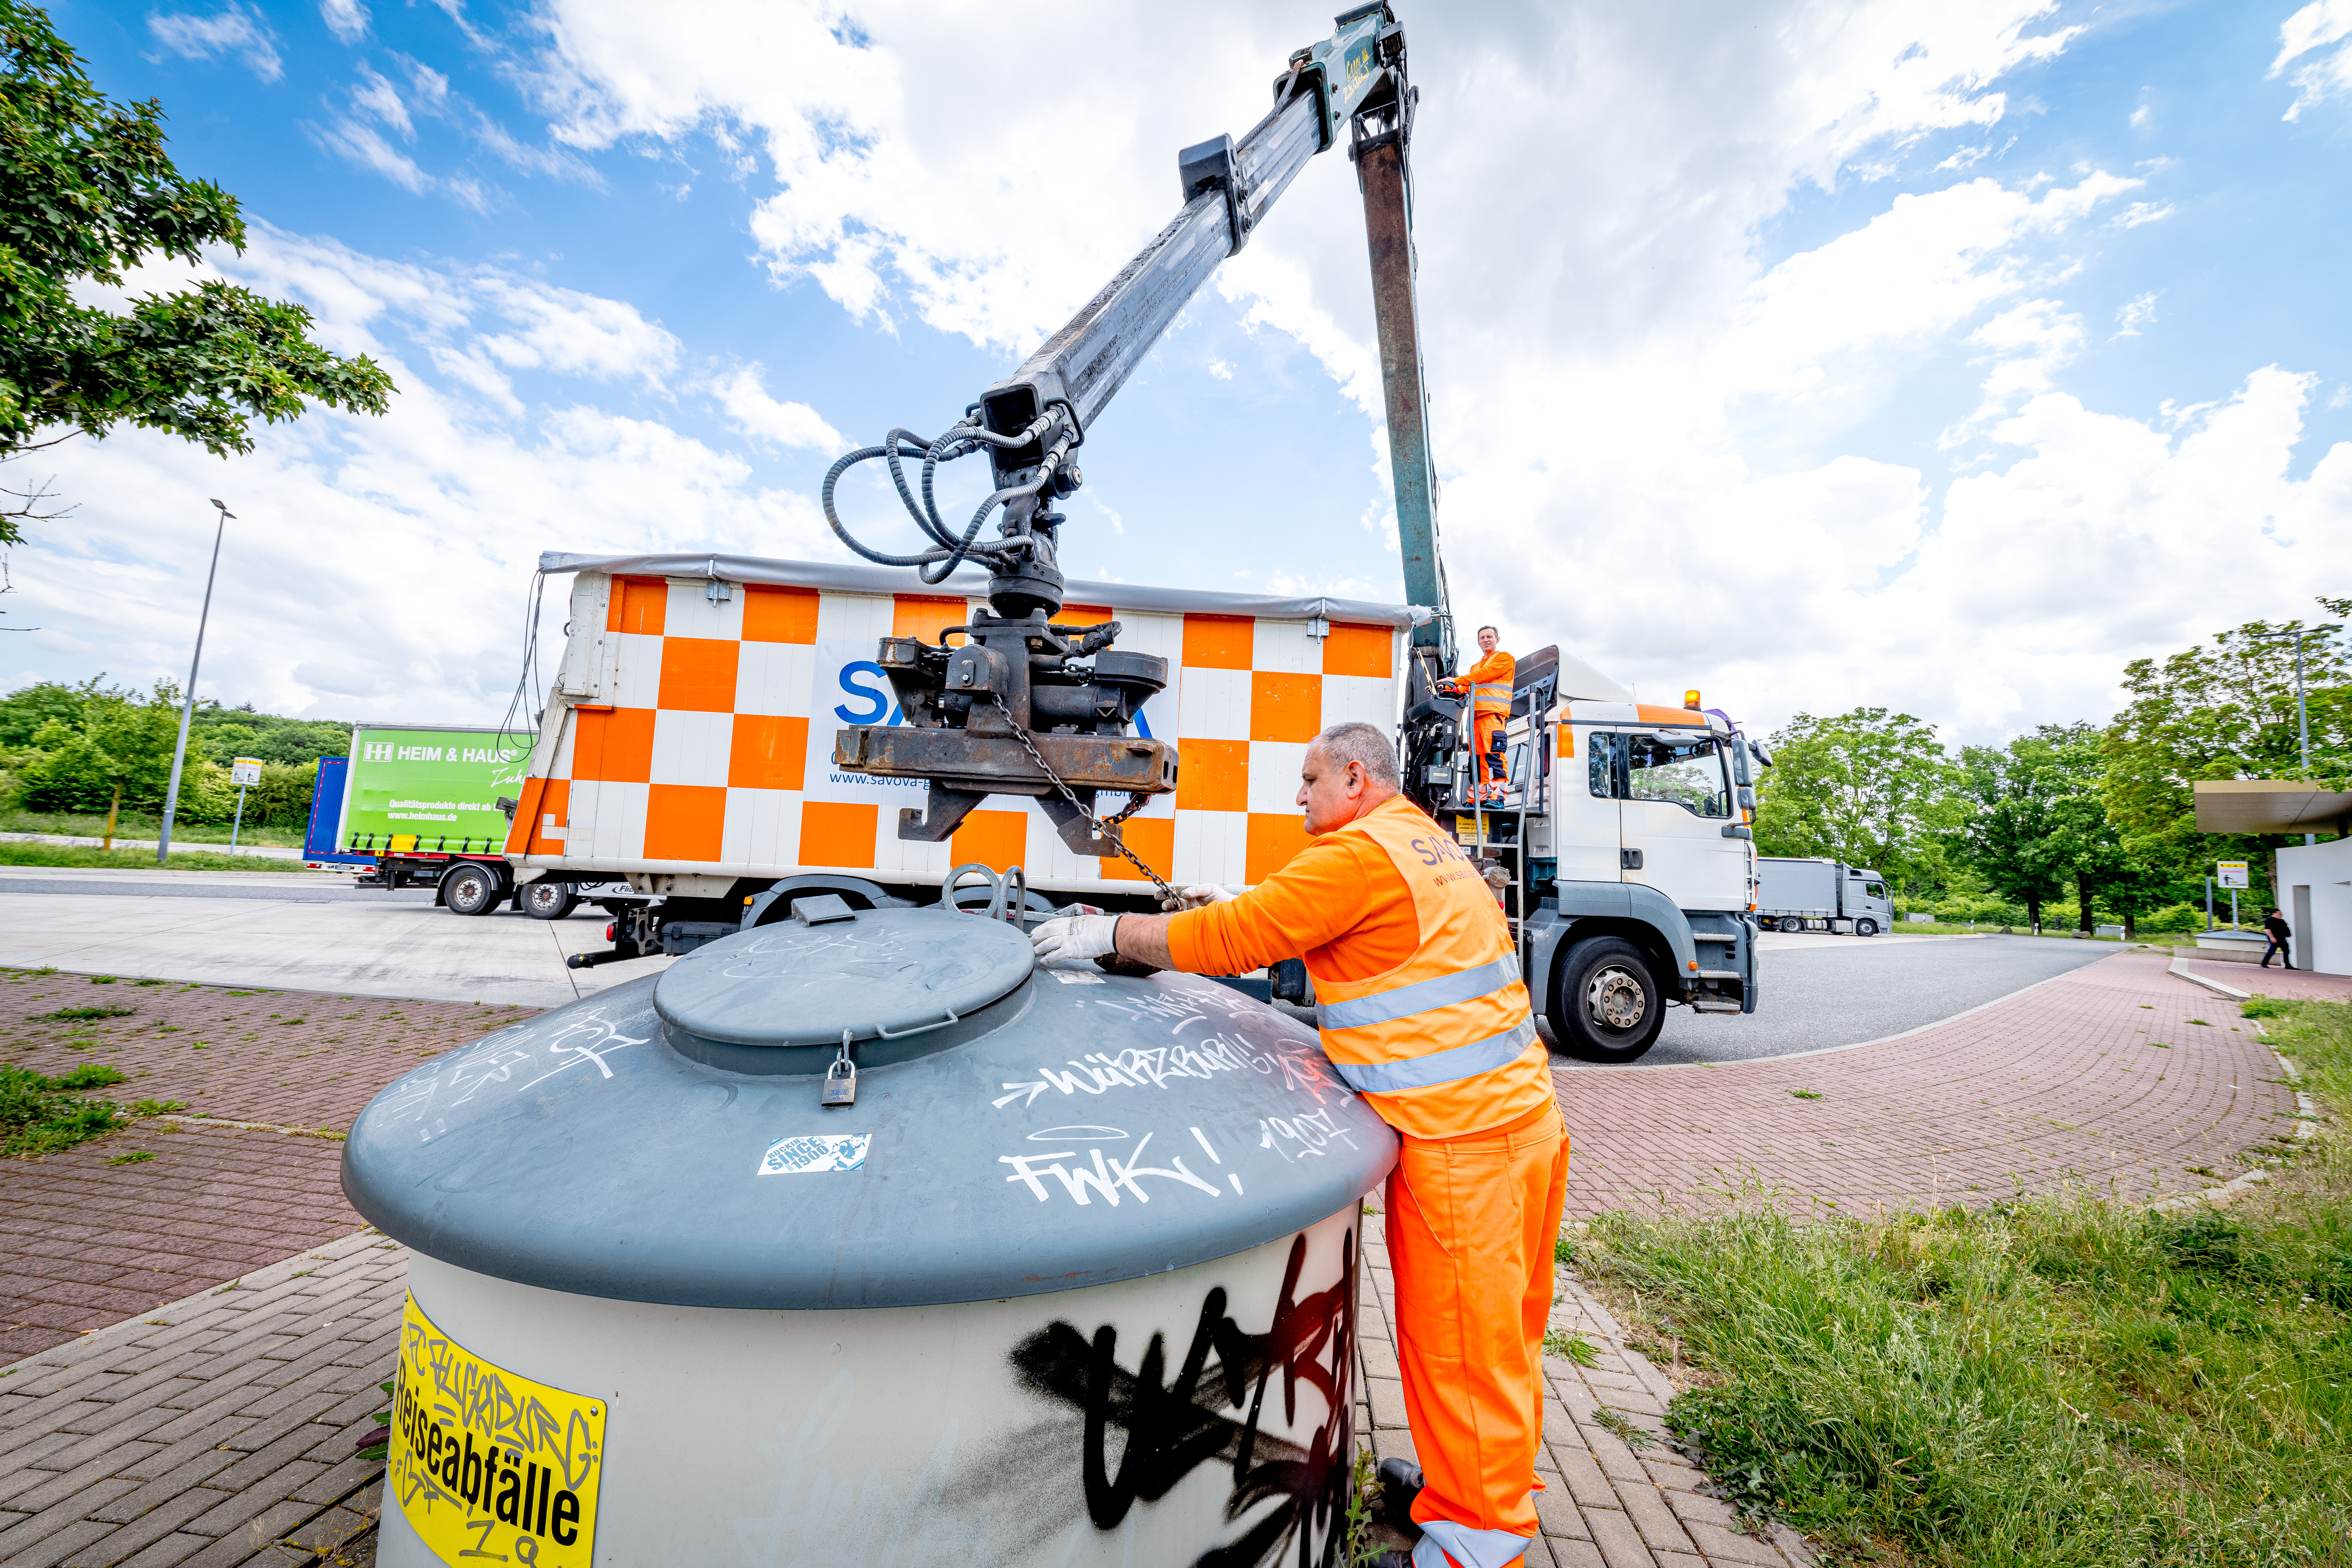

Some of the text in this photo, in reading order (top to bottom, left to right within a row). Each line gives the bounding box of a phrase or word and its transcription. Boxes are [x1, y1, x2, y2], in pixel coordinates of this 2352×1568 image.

[398, 746, 442, 761] HEIM
[446, 747, 458, 762] &
[389, 799, 456, 810] Qualitätsprodukte
[457, 802, 480, 811] direkt
[481, 803, 491, 811] ab
[387, 811, 457, 821] www.heimhaus.de
[767, 1137, 800, 1160] ROCKIN'
[767, 1136, 822, 1170] SINCE
[790, 1145, 830, 1169] 1900
[784, 1164, 794, 1172] NORD
[395, 1354, 580, 1547] Reiseabfälle
